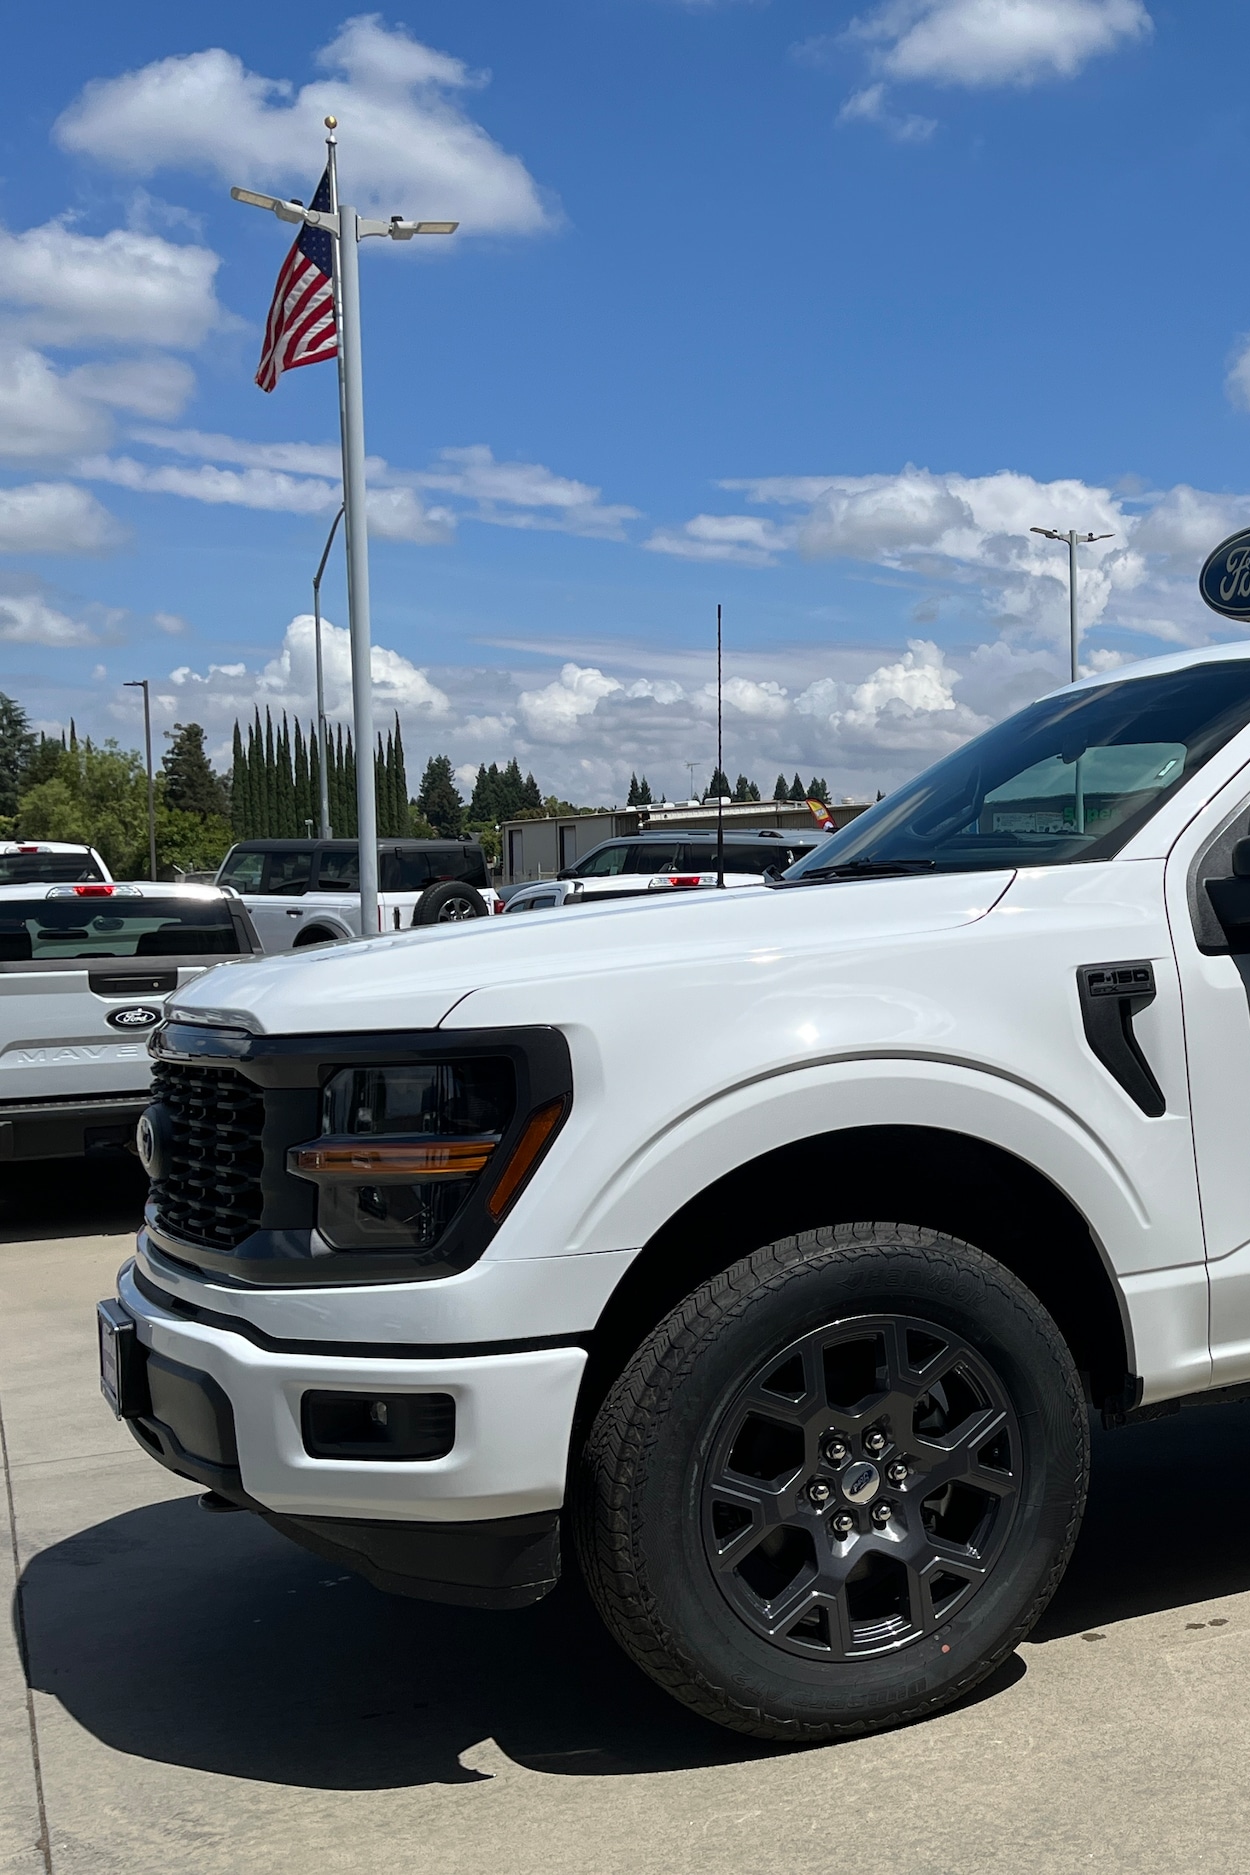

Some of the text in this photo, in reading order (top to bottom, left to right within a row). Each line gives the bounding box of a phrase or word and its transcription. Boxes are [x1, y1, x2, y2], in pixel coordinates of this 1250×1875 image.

[1063, 806, 1118, 824] Sper
[1087, 968, 1150, 986] F-150
[122, 1011, 148, 1023] Ford
[17, 1045, 138, 1063] MAVE
